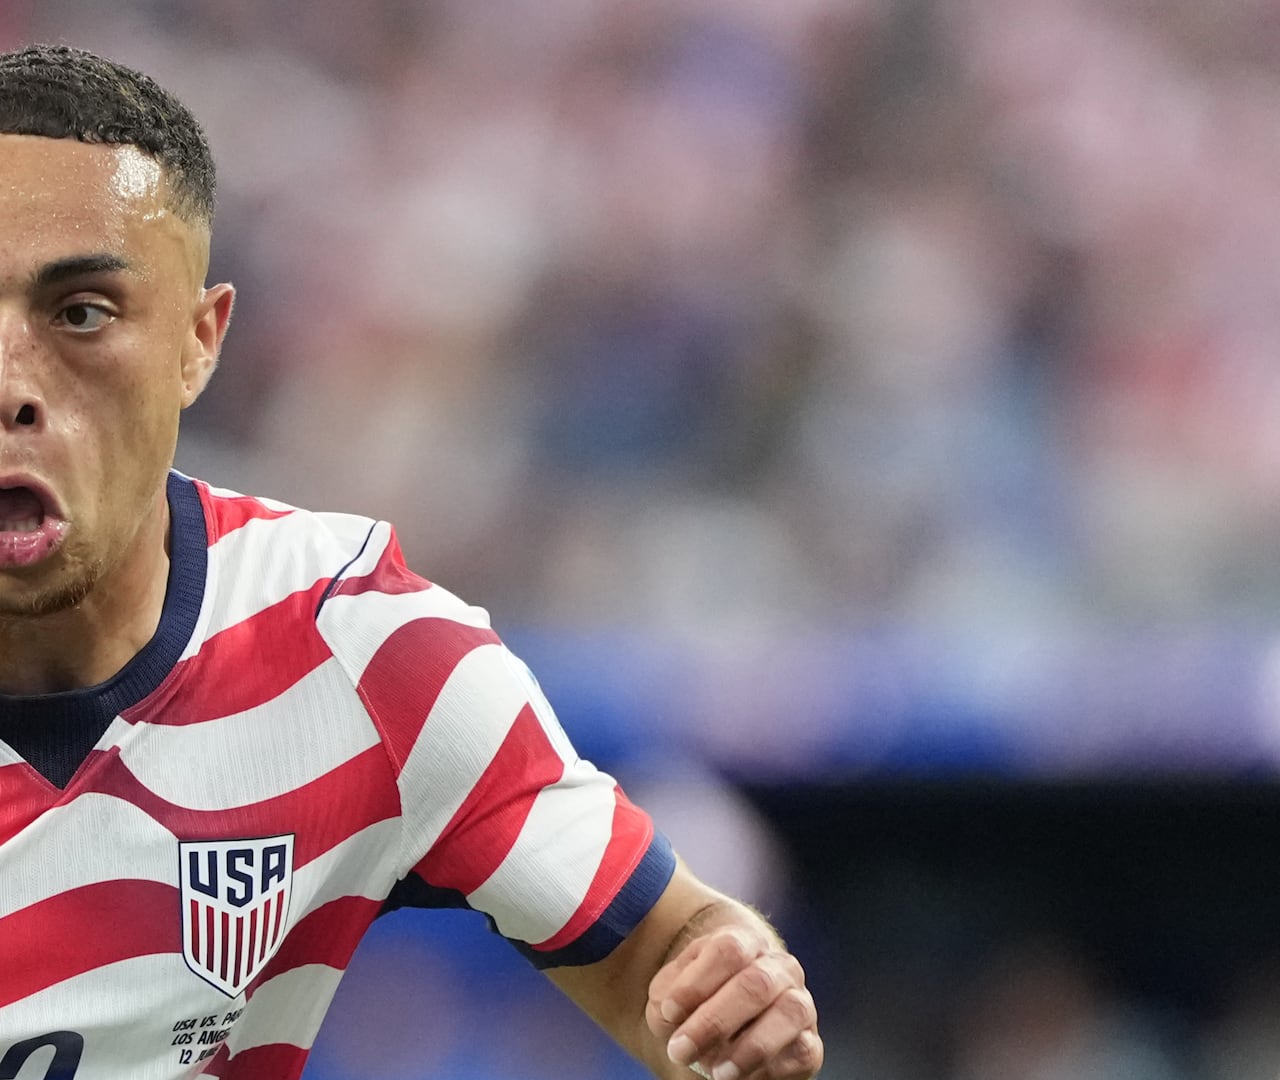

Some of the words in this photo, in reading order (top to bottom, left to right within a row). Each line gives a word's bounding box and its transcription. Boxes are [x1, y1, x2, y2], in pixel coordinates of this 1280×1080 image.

[189, 844, 286, 907] USA
[172, 1018, 198, 1032] USA
[200, 1014, 218, 1028] VS.
[171, 1032, 196, 1046] LOS
[179, 1049, 192, 1065] 12
